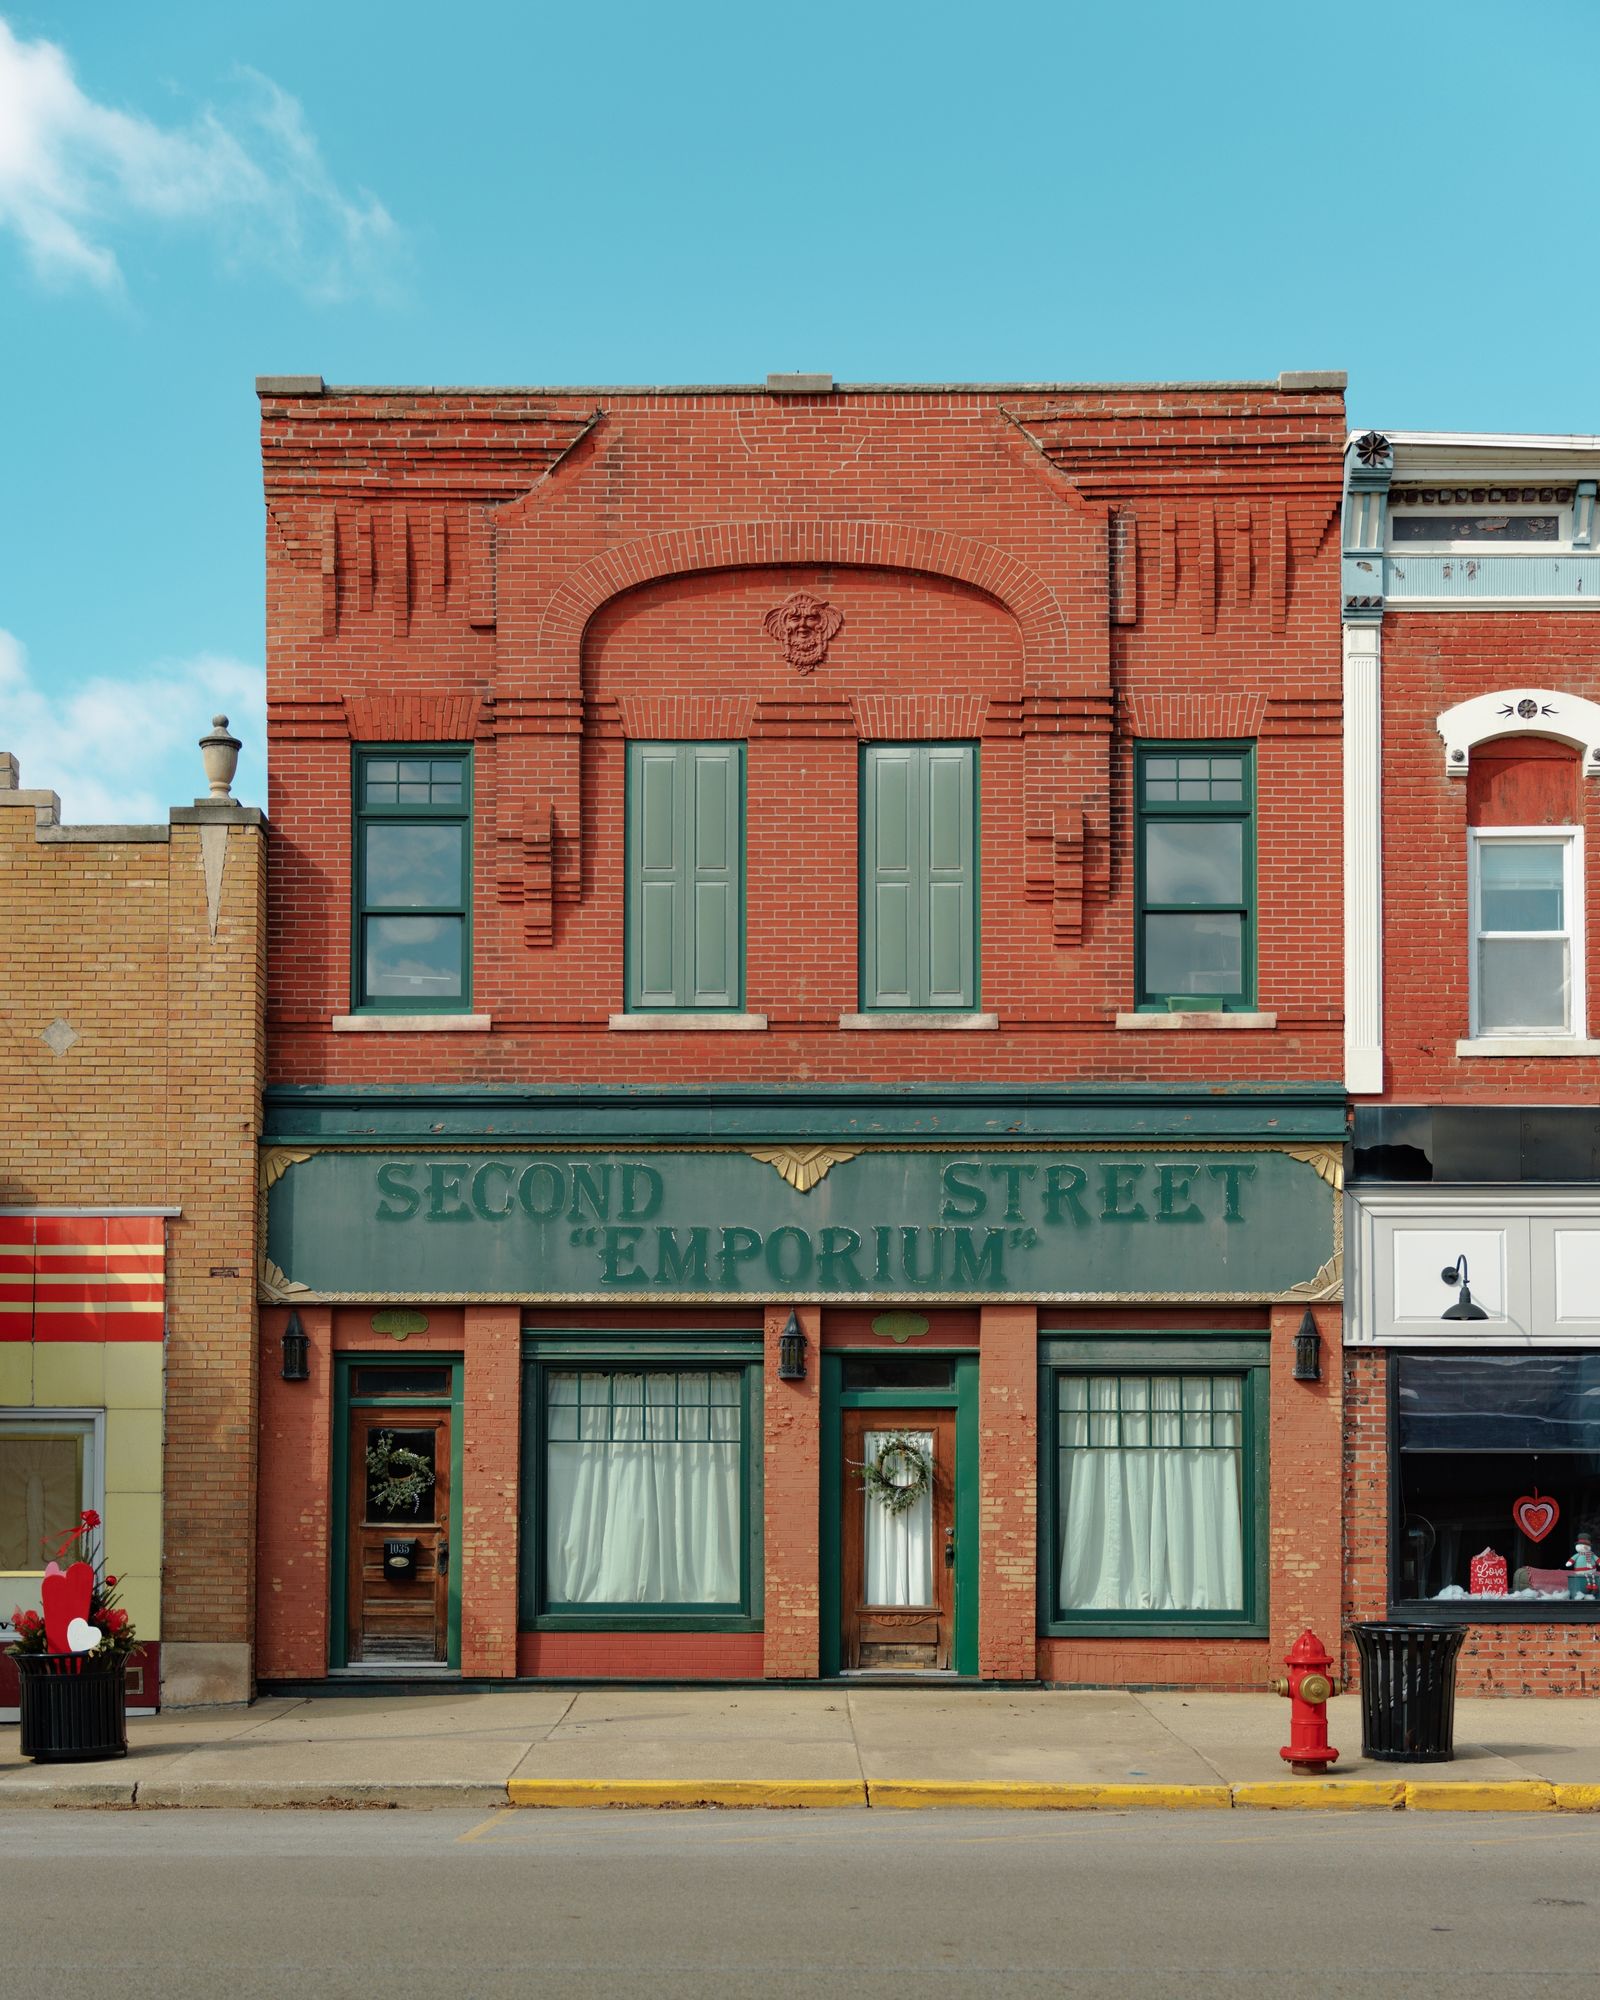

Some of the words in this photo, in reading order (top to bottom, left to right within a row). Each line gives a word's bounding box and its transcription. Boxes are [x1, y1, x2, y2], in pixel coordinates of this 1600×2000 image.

[376, 1161, 664, 1222] SECOND
[940, 1161, 1258, 1224] STREET
[390, 1543, 410, 1554] 1035
[1476, 1562, 1505, 1578] Love
